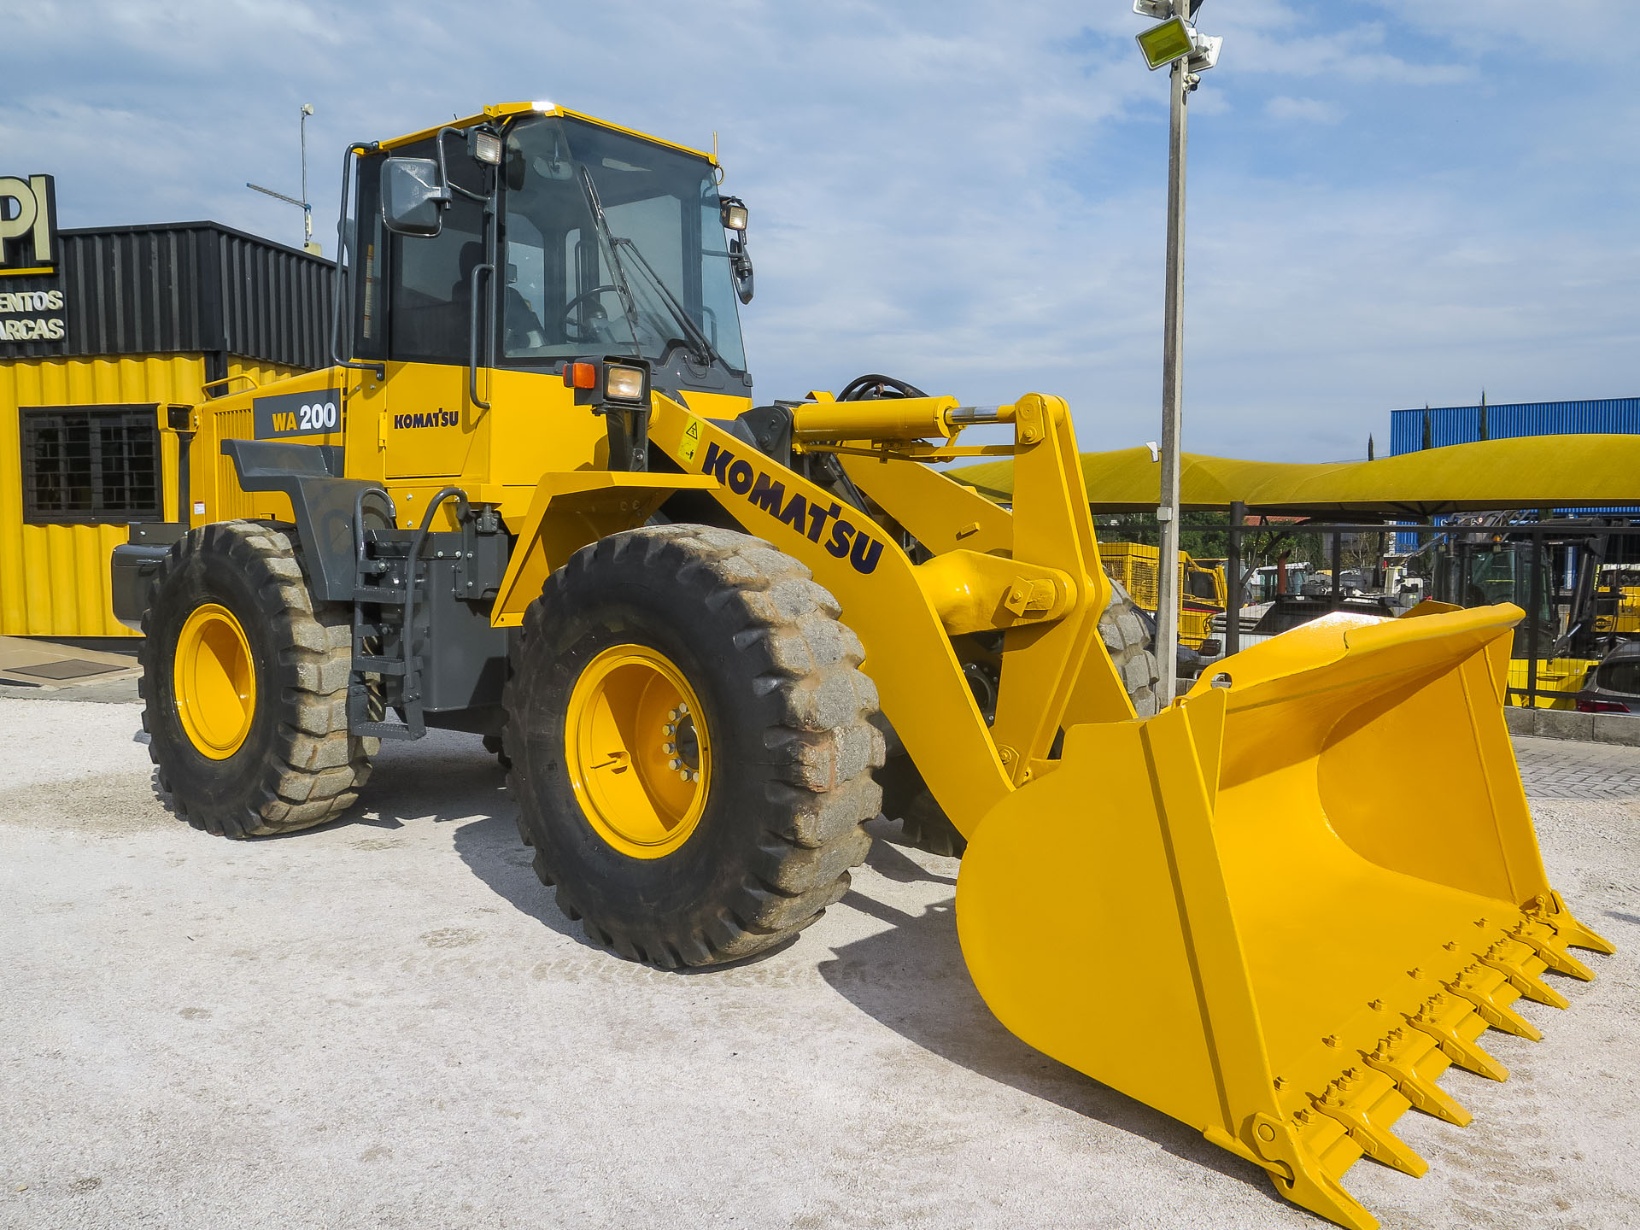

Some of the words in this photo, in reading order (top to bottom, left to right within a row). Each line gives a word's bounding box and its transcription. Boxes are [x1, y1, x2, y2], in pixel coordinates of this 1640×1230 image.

[272, 411, 298, 432] WA
[300, 402, 337, 430] 200
[394, 408, 459, 429] KOMATSU
[701, 441, 885, 575] KOMATSU
